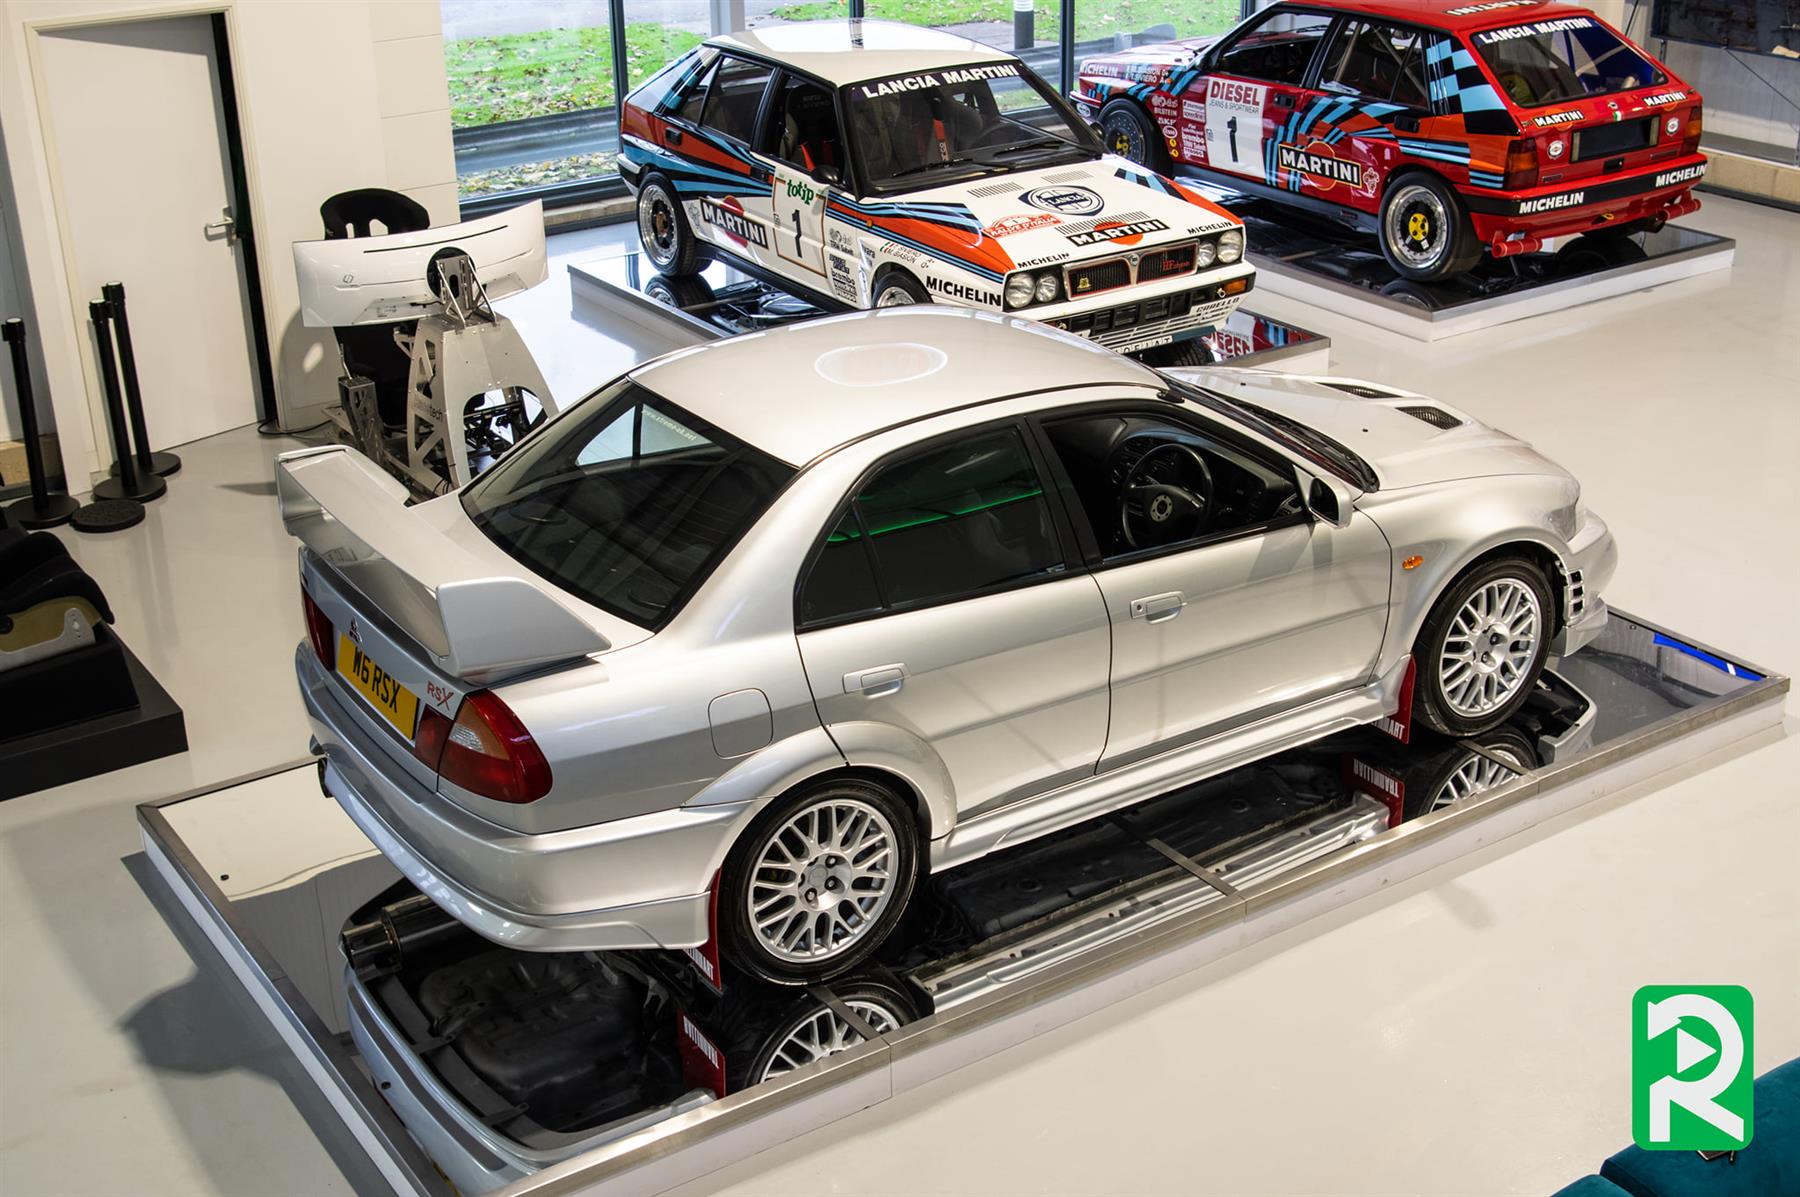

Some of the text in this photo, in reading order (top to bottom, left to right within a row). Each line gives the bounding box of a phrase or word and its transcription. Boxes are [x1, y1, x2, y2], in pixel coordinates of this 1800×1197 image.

[1479, 18, 1592, 44] LANCIA MARTINI
[862, 64, 1020, 98] LANCIA MARTINI
[1210, 80, 1260, 106] DIESEL
[1209, 100, 1224, 109] JEANS
[1229, 102, 1259, 114] SPORTWEAR
[1643, 91, 1686, 106] MARTINI
[1534, 110, 1584, 127] MARTINI
[1226, 116, 1239, 162] 1
[1282, 148, 1358, 184] MARTINI
[1655, 164, 1707, 187] MICHELIN
[787, 180, 815, 205] totip
[1519, 192, 1584, 214] MICHELIN
[702, 201, 766, 246] MARTINI
[792, 209, 802, 258] 1
[1070, 220, 1165, 246] MARTINI
[1187, 222, 1233, 236] MICHELIN
[1017, 252, 1071, 269] MICHELIN
[926, 275, 1002, 307] MICHELIN
[353, 646, 401, 714] W6 RSX
[427, 680, 454, 711] RSX
